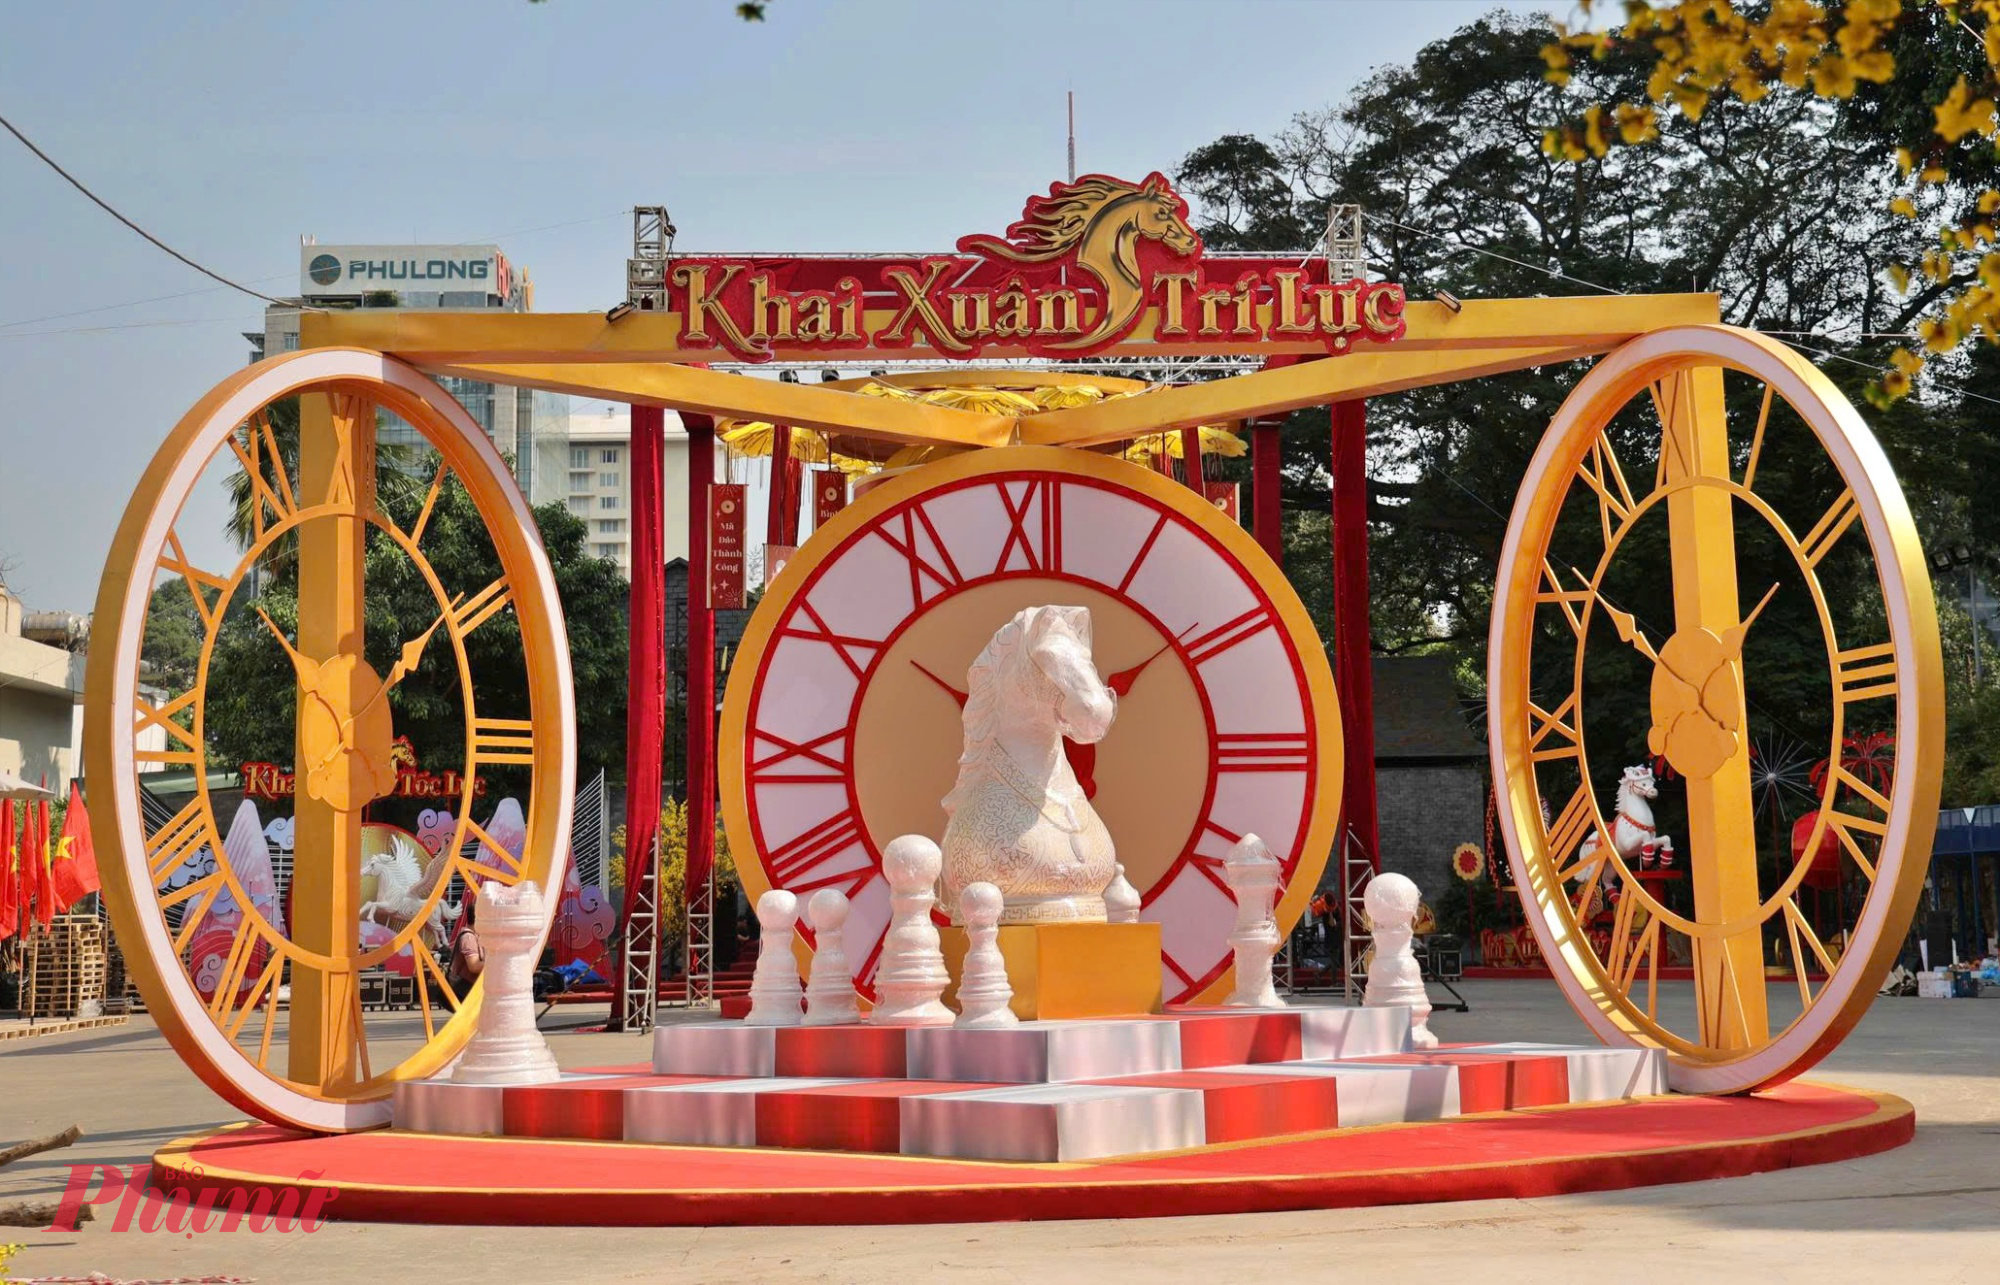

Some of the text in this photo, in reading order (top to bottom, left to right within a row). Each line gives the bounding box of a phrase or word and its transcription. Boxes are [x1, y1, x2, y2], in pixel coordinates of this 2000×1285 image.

[349, 260, 488, 280] PHULONG
[671, 260, 1402, 354] Khai Xuân Trí Lực
[713, 549, 743, 558] Thành
[715, 563, 739, 574] Công
[245, 764, 295, 799] Kha
